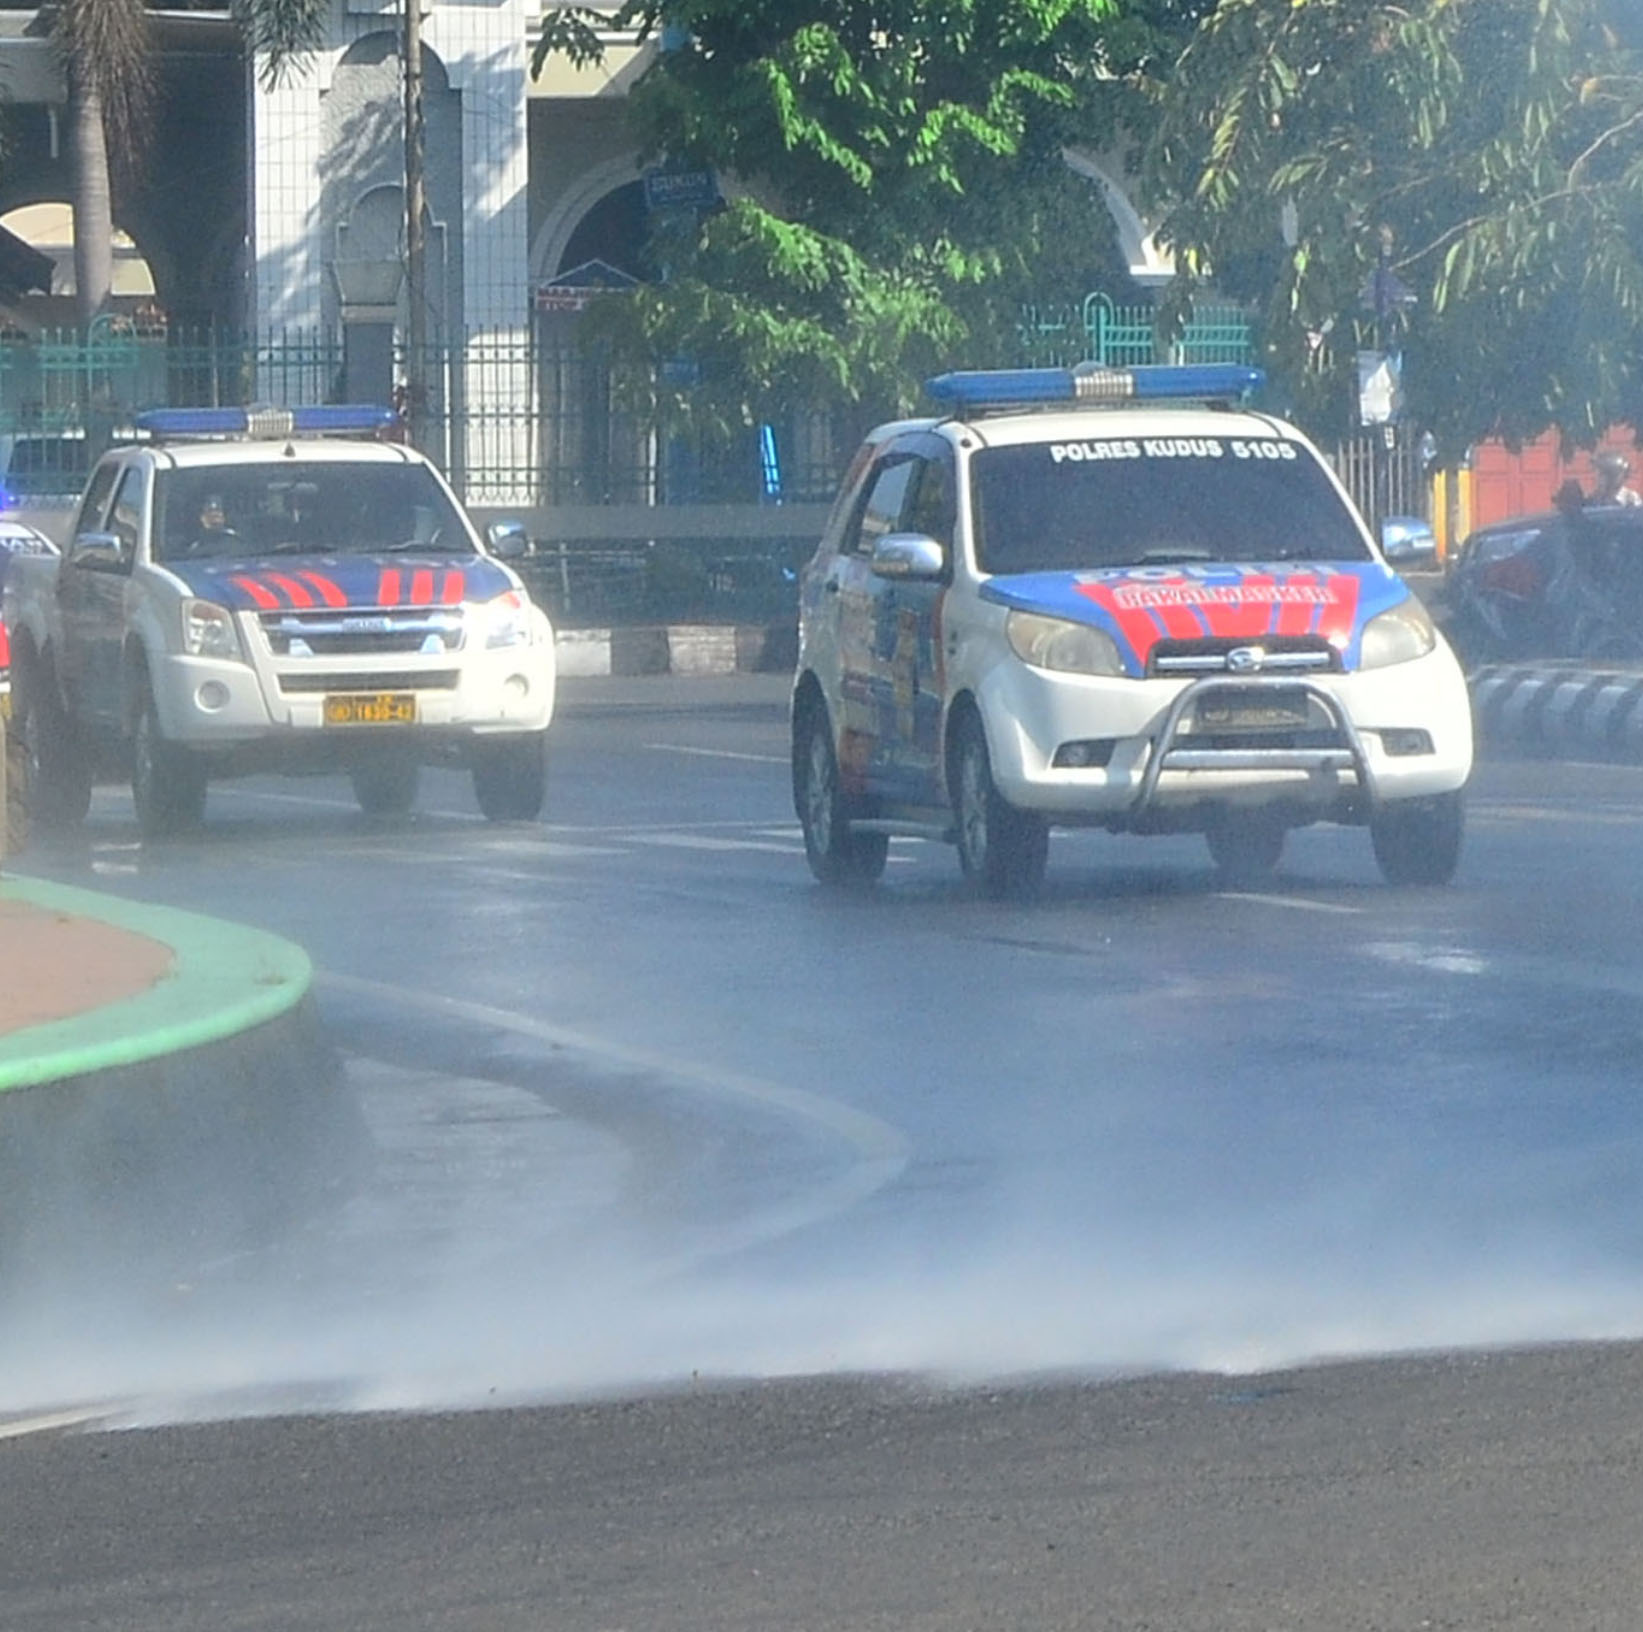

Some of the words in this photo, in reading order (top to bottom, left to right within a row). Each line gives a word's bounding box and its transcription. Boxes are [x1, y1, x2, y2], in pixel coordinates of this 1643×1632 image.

[1050, 440, 1141, 463] POLRES
[1143, 438, 1223, 458] KUDUS
[1231, 440, 1297, 460] 5105
